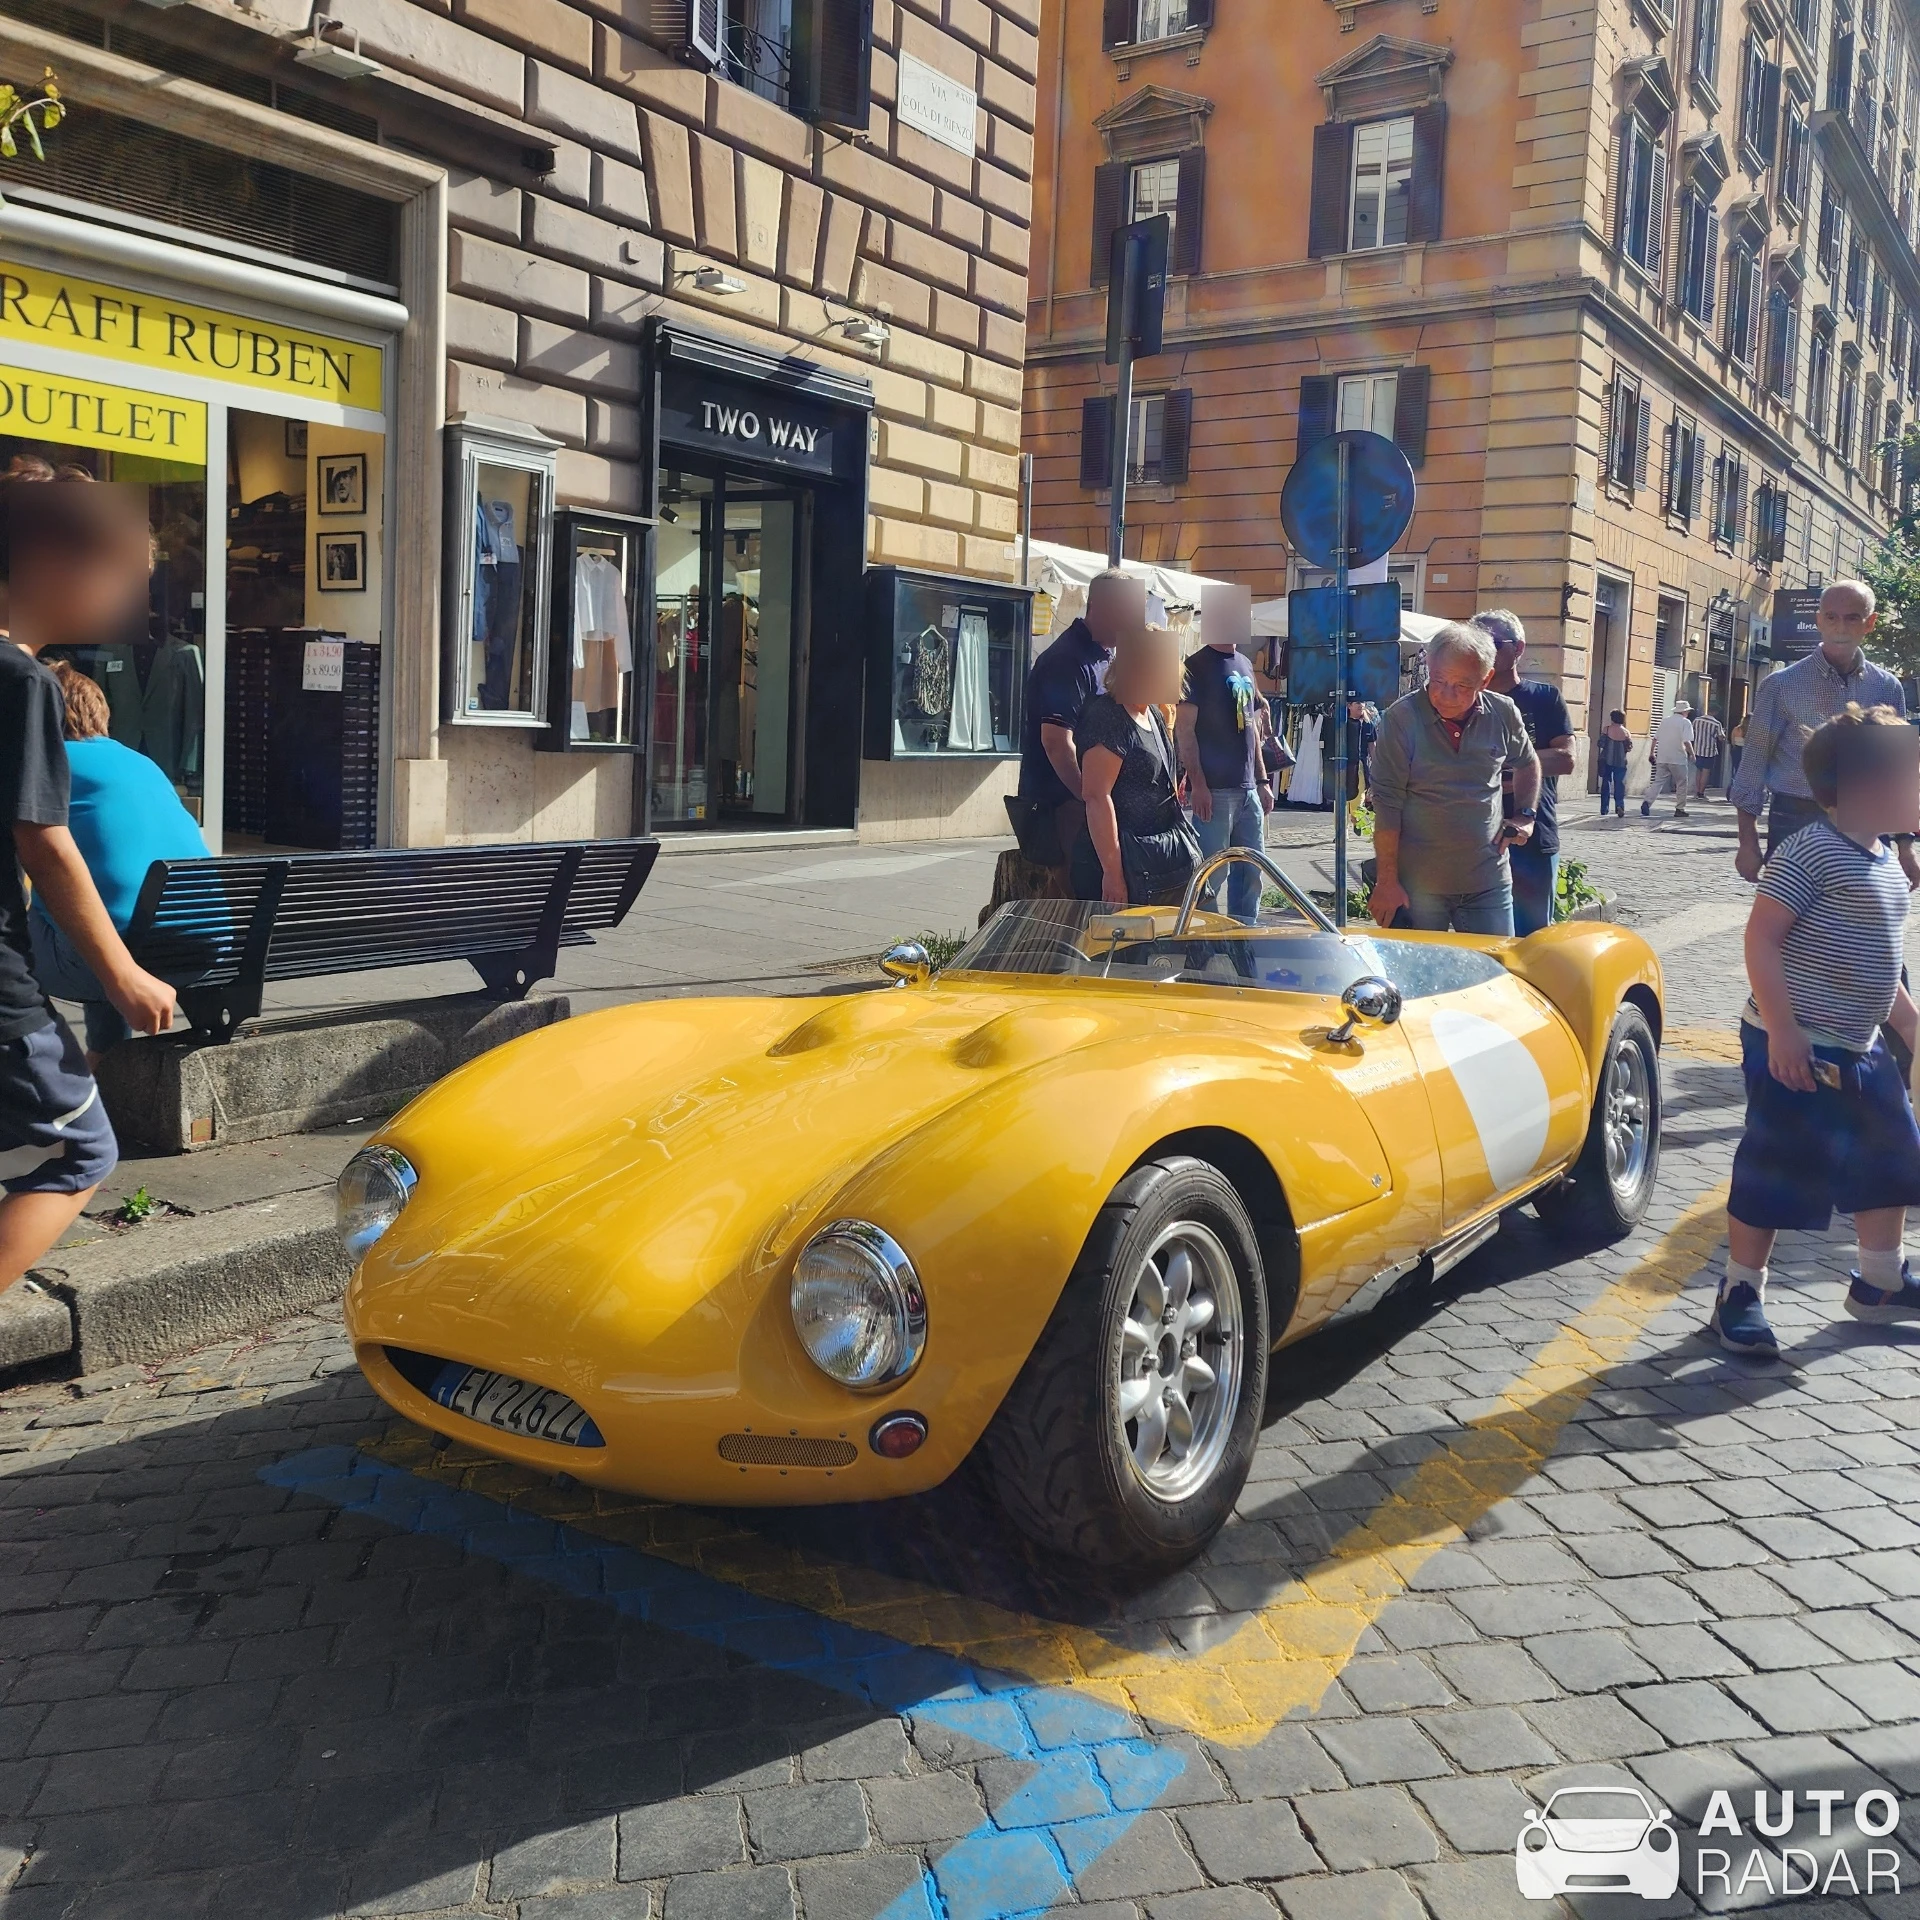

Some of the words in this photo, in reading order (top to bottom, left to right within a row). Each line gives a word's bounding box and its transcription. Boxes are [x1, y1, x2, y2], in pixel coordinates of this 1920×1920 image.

[931, 82, 947, 102] VIA
[902, 94, 928, 118] COLA
[930, 109, 940, 124] DI
[944, 116, 972, 141] RIENZO
[0, 273, 144, 350] RAFI
[163, 311, 355, 394] RUBEN
[701, 400, 760, 439] TWO
[768, 417, 819, 452] WAY
[305, 664, 311, 676] 3
[319, 664, 341, 677] 89.90
